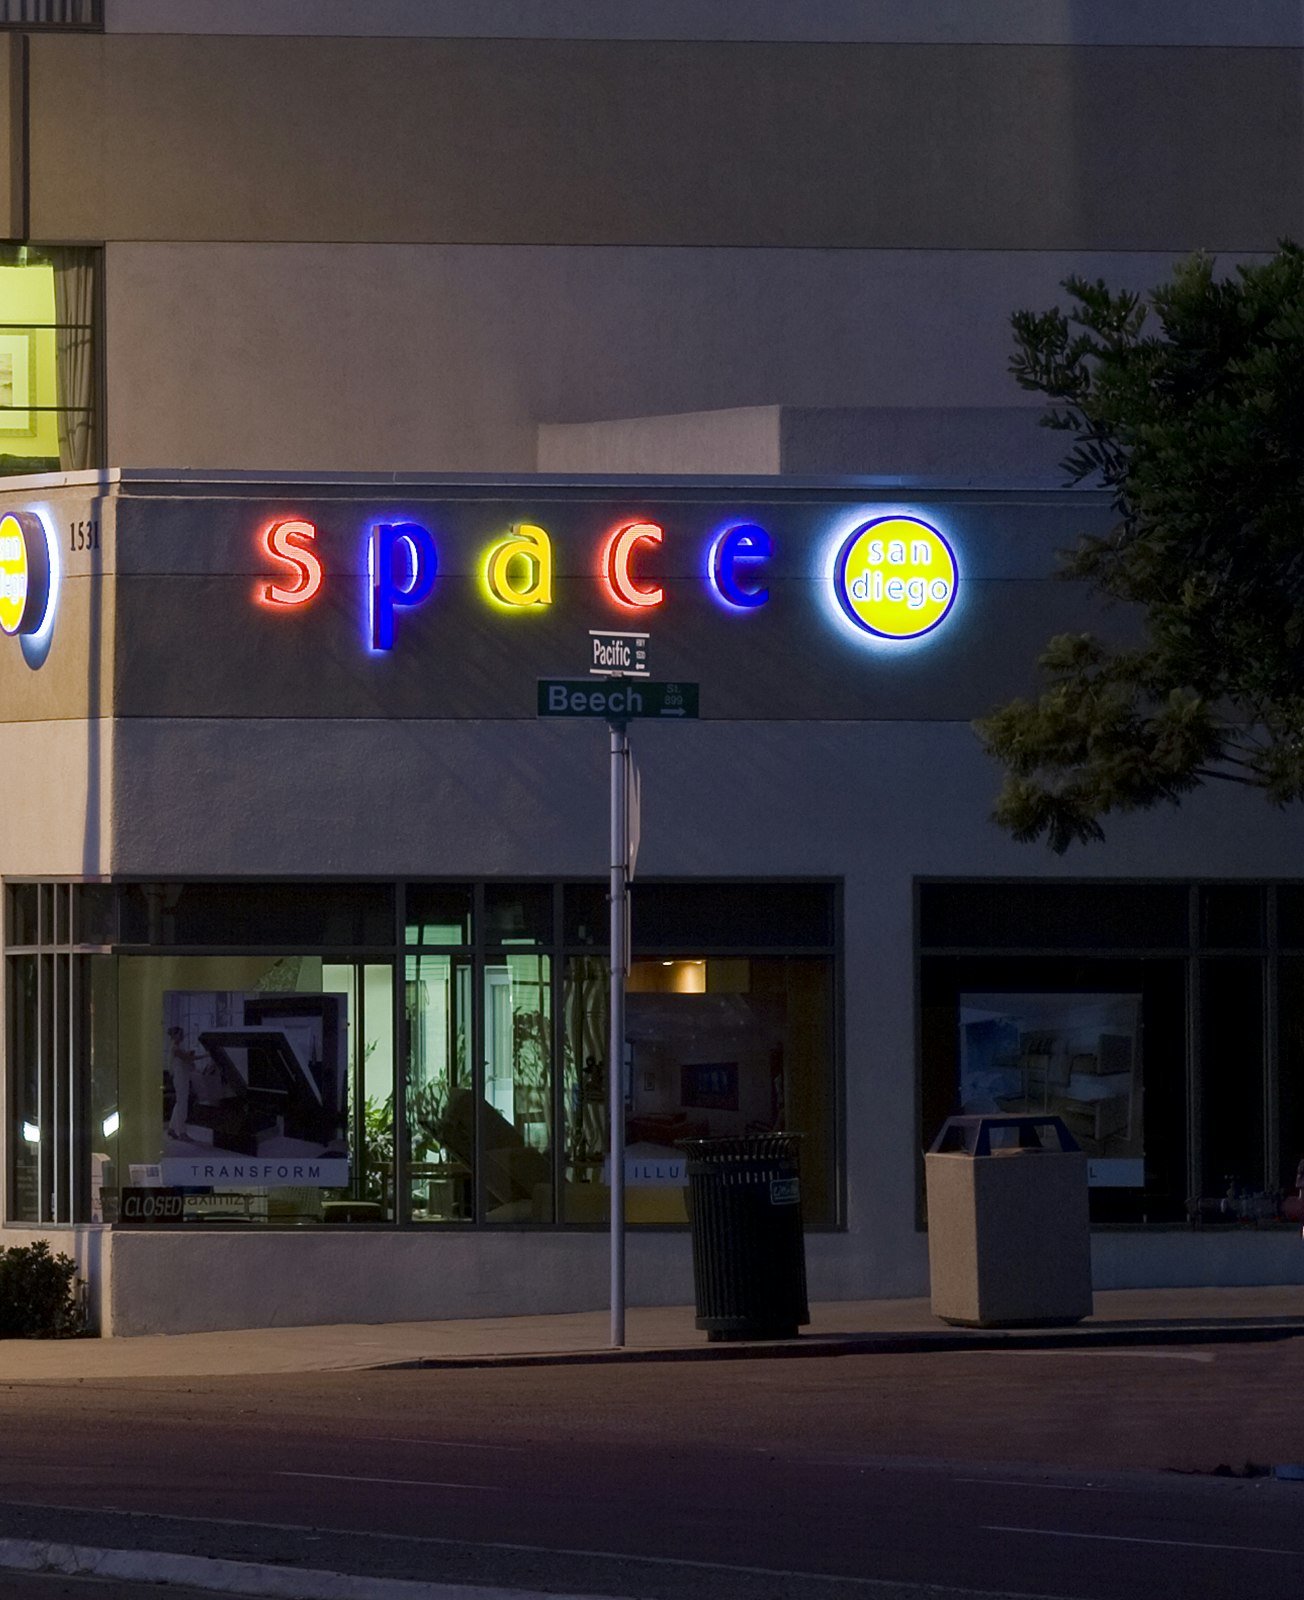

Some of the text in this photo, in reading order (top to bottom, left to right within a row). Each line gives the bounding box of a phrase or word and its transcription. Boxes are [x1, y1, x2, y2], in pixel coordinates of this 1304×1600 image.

[70, 521, 99, 552] 1531
[867, 539, 932, 566] san
[264, 518, 773, 650] space
[851, 568, 949, 610] diego
[593, 638, 631, 666] Pacific
[548, 684, 681, 712] Beech St.
[664, 695, 683, 705] 899
[192, 1165, 322, 1179] TRANSFORM
[634, 1166, 688, 1179] ILLU
[124, 1195, 183, 1217] CLOSED
[182, 1195, 255, 1206] aximize
